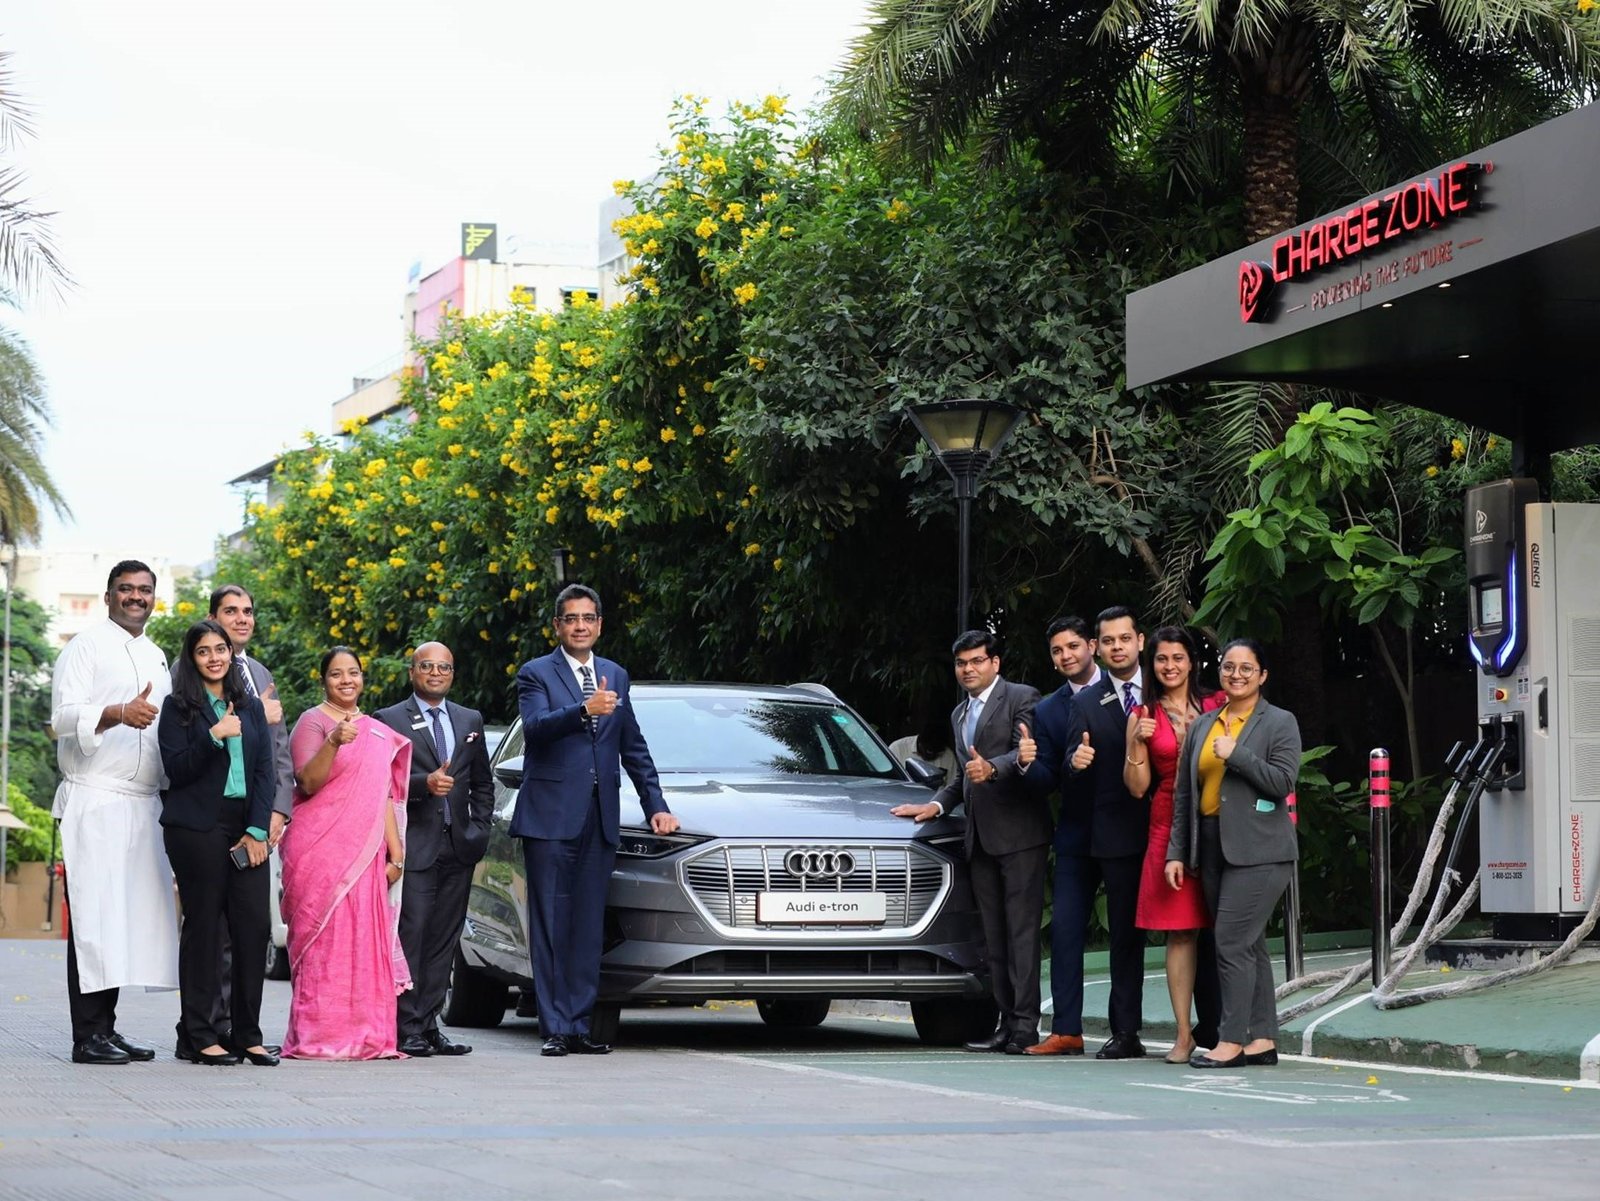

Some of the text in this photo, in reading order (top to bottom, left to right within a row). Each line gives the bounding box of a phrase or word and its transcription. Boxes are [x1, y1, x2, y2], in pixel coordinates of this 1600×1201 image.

[1311, 241, 1453, 311] POWERING THE FUTURE
[1531, 543, 1540, 588] QUENCH
[785, 902, 859, 912] Audi e-tron
